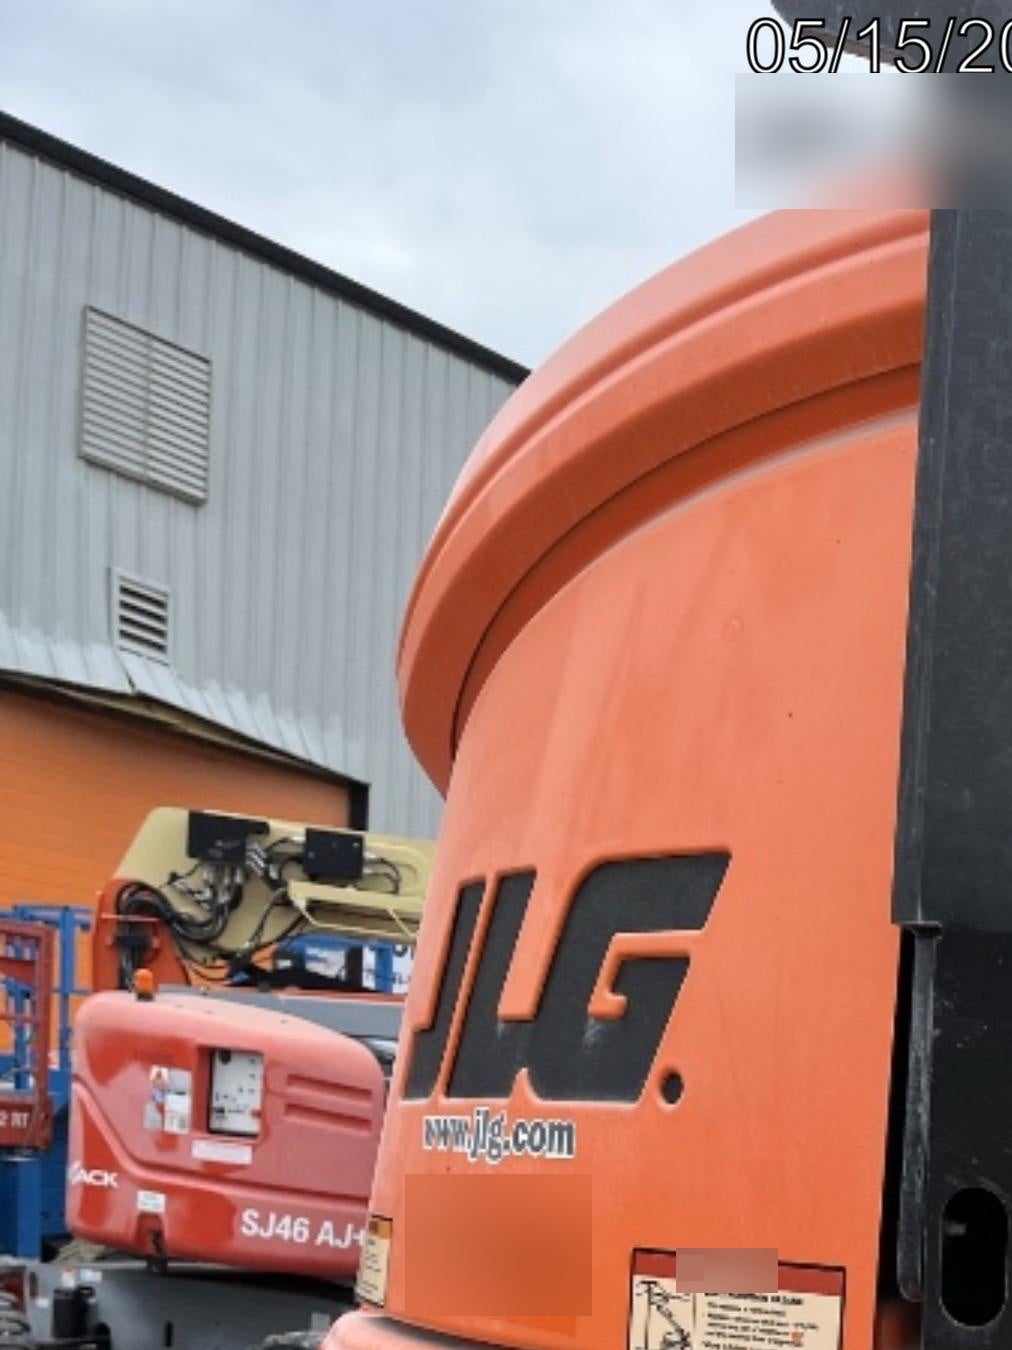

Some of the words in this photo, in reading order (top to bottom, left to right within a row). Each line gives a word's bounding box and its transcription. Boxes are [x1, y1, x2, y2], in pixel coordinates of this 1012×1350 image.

[401, 851, 732, 1105] JLG
[425, 1109, 575, 1161] www.jlg.com
[240, 1208, 311, 1243] SJ46
